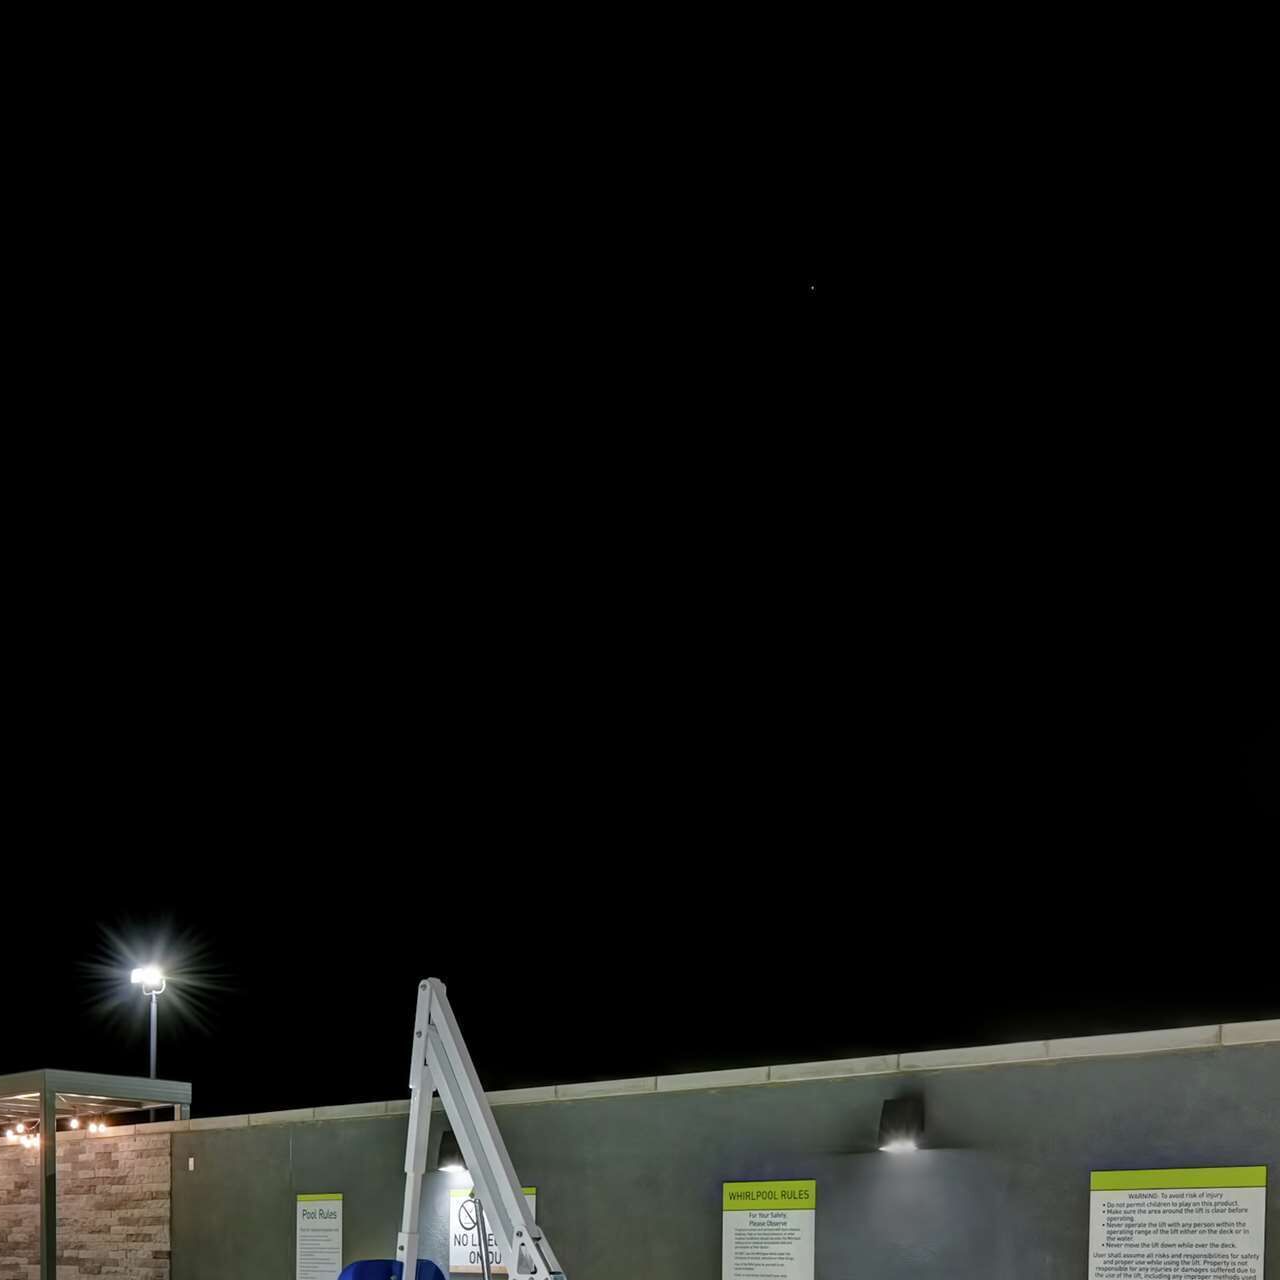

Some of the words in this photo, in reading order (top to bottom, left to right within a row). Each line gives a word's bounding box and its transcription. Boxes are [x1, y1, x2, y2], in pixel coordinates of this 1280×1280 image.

[728, 1190, 778, 1201] WHIRLPOOL
[780, 1190, 810, 1200] RULES
[302, 1208, 317, 1220] Pool
[318, 1208, 337, 1220] Rules
[454, 1234, 468, 1247] NO
